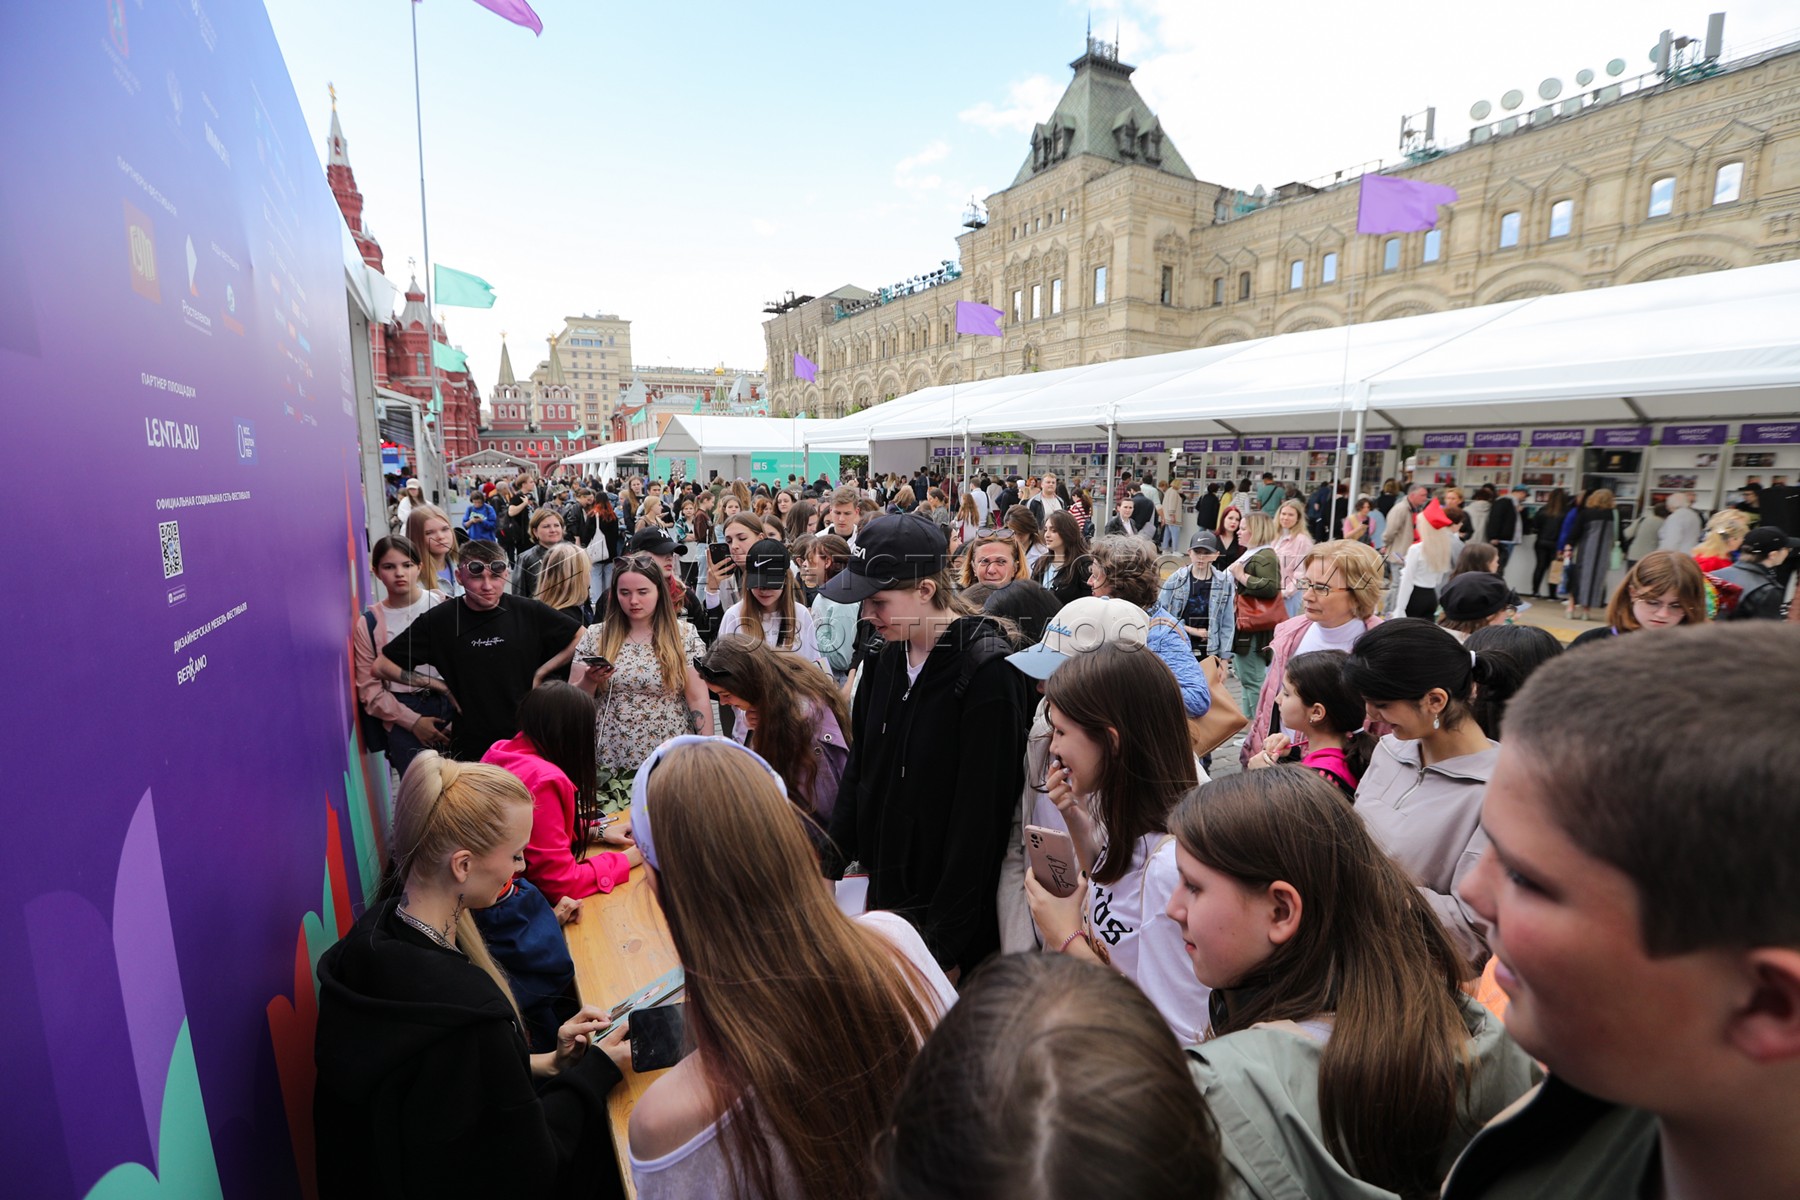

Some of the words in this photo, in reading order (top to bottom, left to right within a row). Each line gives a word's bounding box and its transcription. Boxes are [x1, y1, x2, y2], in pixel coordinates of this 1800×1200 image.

[141, 372, 167, 391] ПАРТНЕР
[167, 380, 197, 399] ПЛОЩАДКИ
[145, 417, 200, 450] LENTA.RU
[1425, 434, 1465, 443] СИНДБАД
[1476, 433, 1519, 442] СИНДБАД
[1534, 432, 1582, 441] СИНДБАД
[156, 496, 195, 511] ОФИЦИАЛЬНАЯ
[195, 493, 223, 506] СОЦИАЛЬНАЯ
[222, 492, 232, 502] СЕТЬ
[231, 491, 251, 501] ФЕСТИВАЛЯ
[174, 622, 211, 655] ДИЗАЙНЕРСКАЯ
[210, 614, 227, 631] МЕБЕЛЬ
[226, 601, 248, 621] ФЕСТИВАЛЯ
[177, 655, 207, 685] BERKANO
